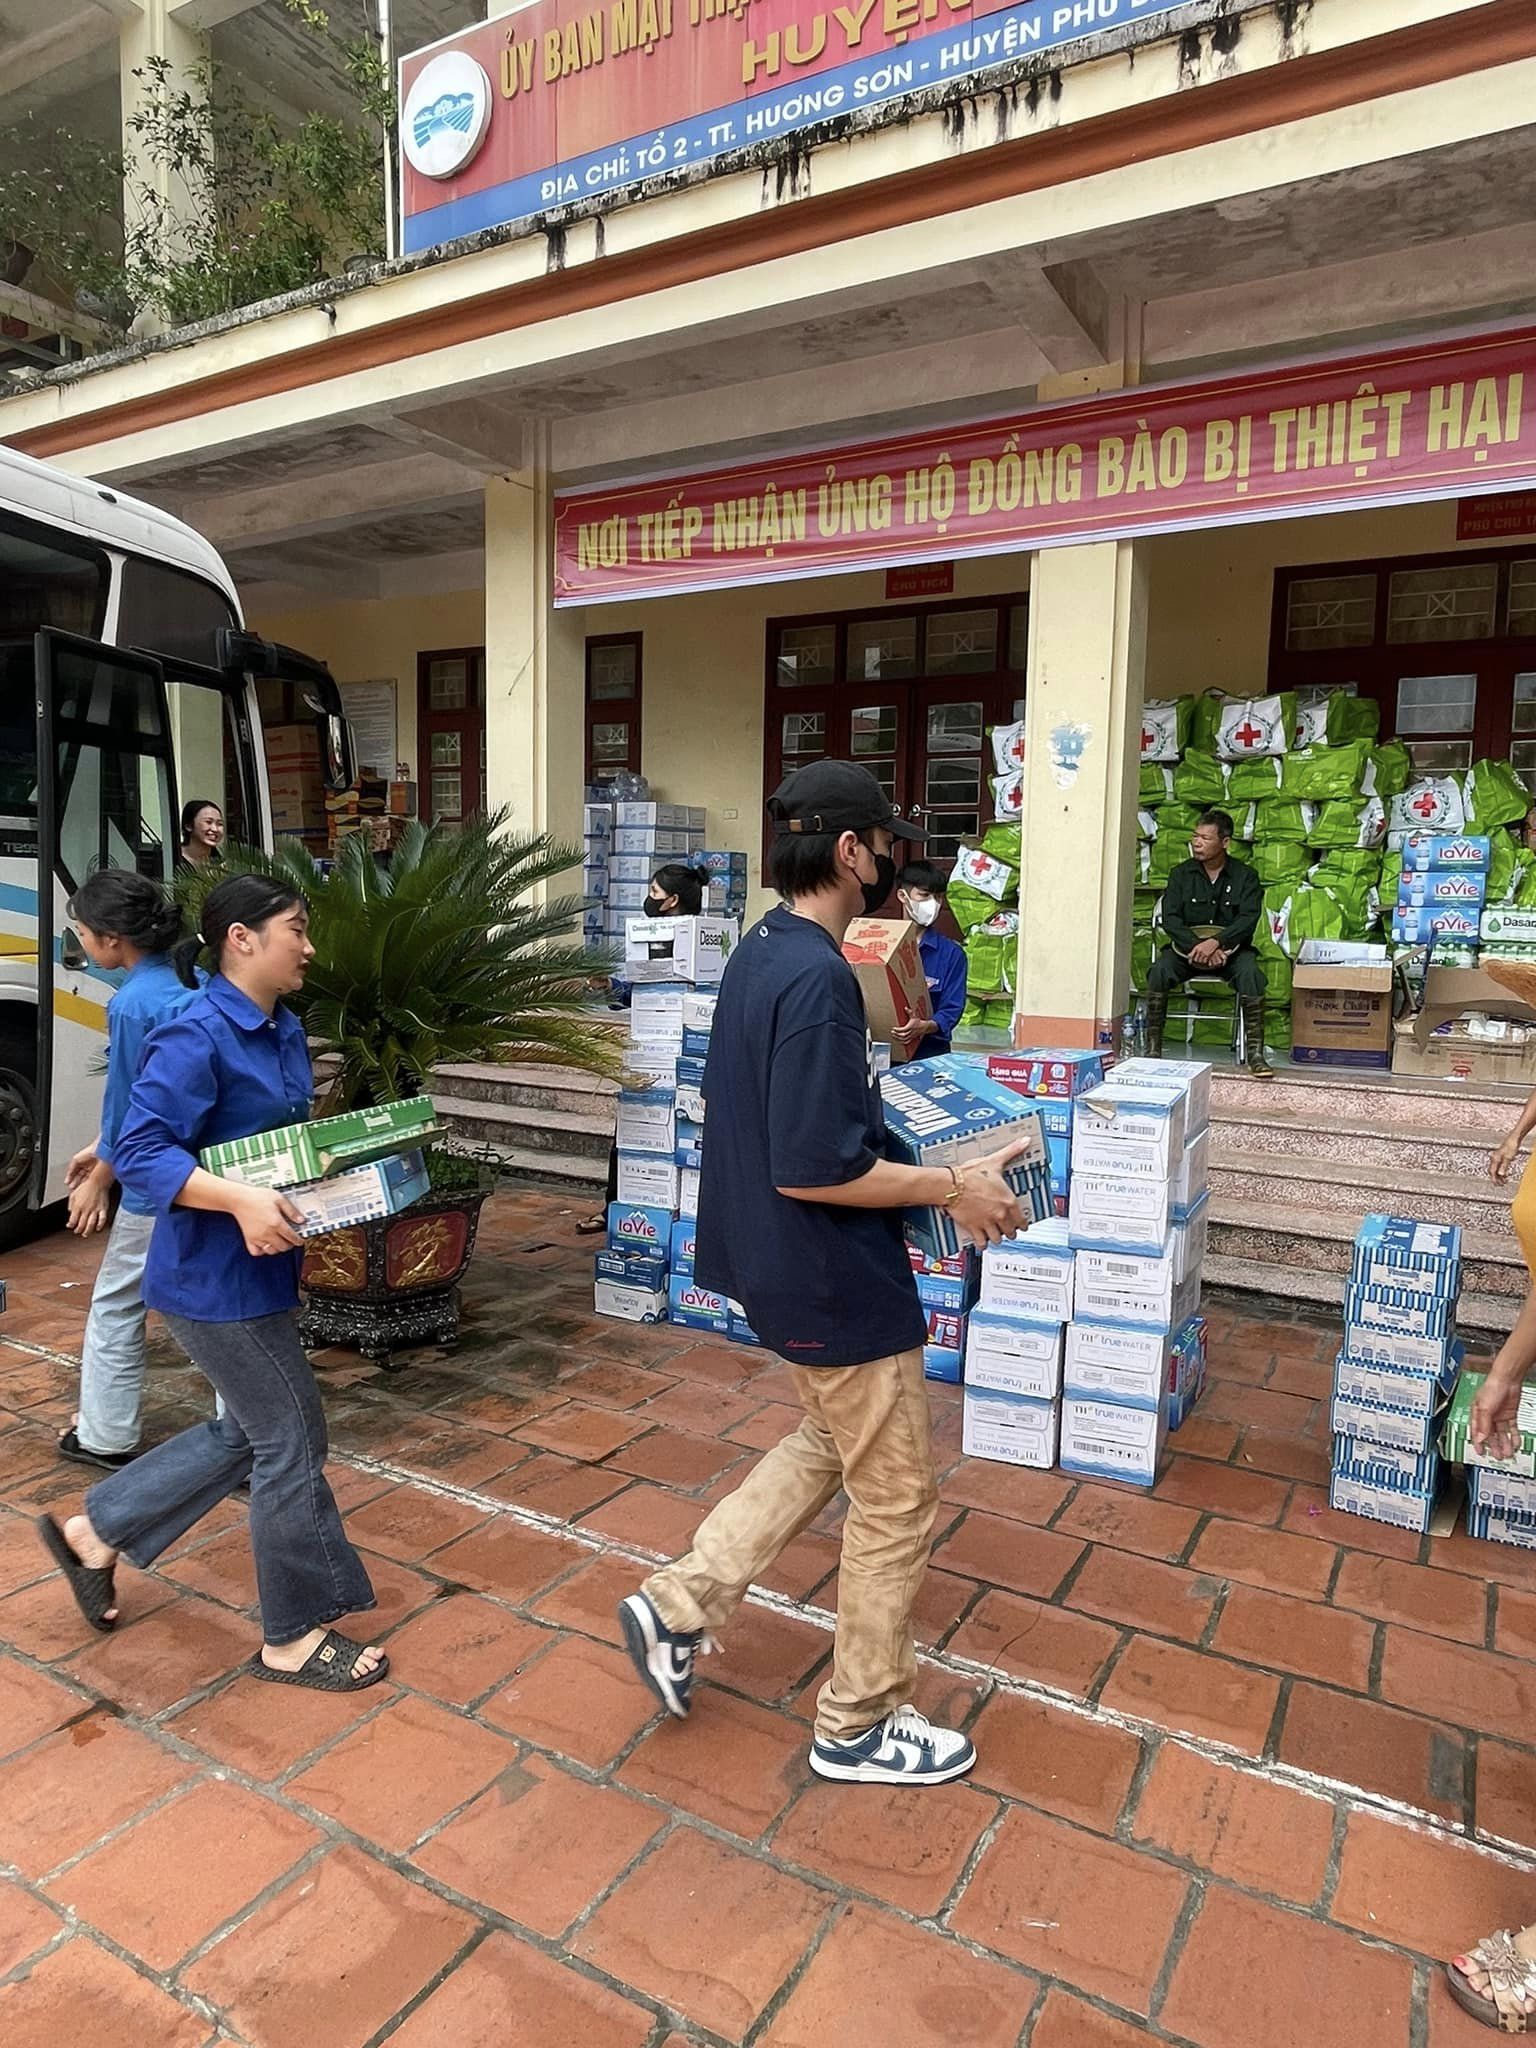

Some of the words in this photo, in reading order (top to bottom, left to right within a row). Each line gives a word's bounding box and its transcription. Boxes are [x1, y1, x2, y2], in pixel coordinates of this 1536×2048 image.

[500, 27, 536, 99] ỦY
[544, 10, 604, 83] BAN
[541, 178, 579, 201] ĐỊA
[585, 147, 630, 187] CHỈ:
[636, 132, 666, 169] TỔ
[673, 137, 688, 158] 2
[708, 121, 736, 147] TT.
[853, 58, 913, 98] SƠN
[939, 17, 1042, 70] HUYỆN
[577, 514, 628, 571] NƠI
[637, 491, 703, 562] TIẾP
[712, 482, 807, 557] NHẬN
[818, 464, 893, 538] ỦNG
[904, 453, 955, 533] HỘ
[967, 432, 1083, 516] ĐỒNG
[1097, 418, 1188, 498] BÀO
[1203, 415, 1252, 493] BỊ
[1269, 382, 1411, 477] THIỆT
[1427, 373, 1524, 462] HẠI
[618, 1219, 657, 1237] laVie
[681, 1289, 721, 1309] laVie
